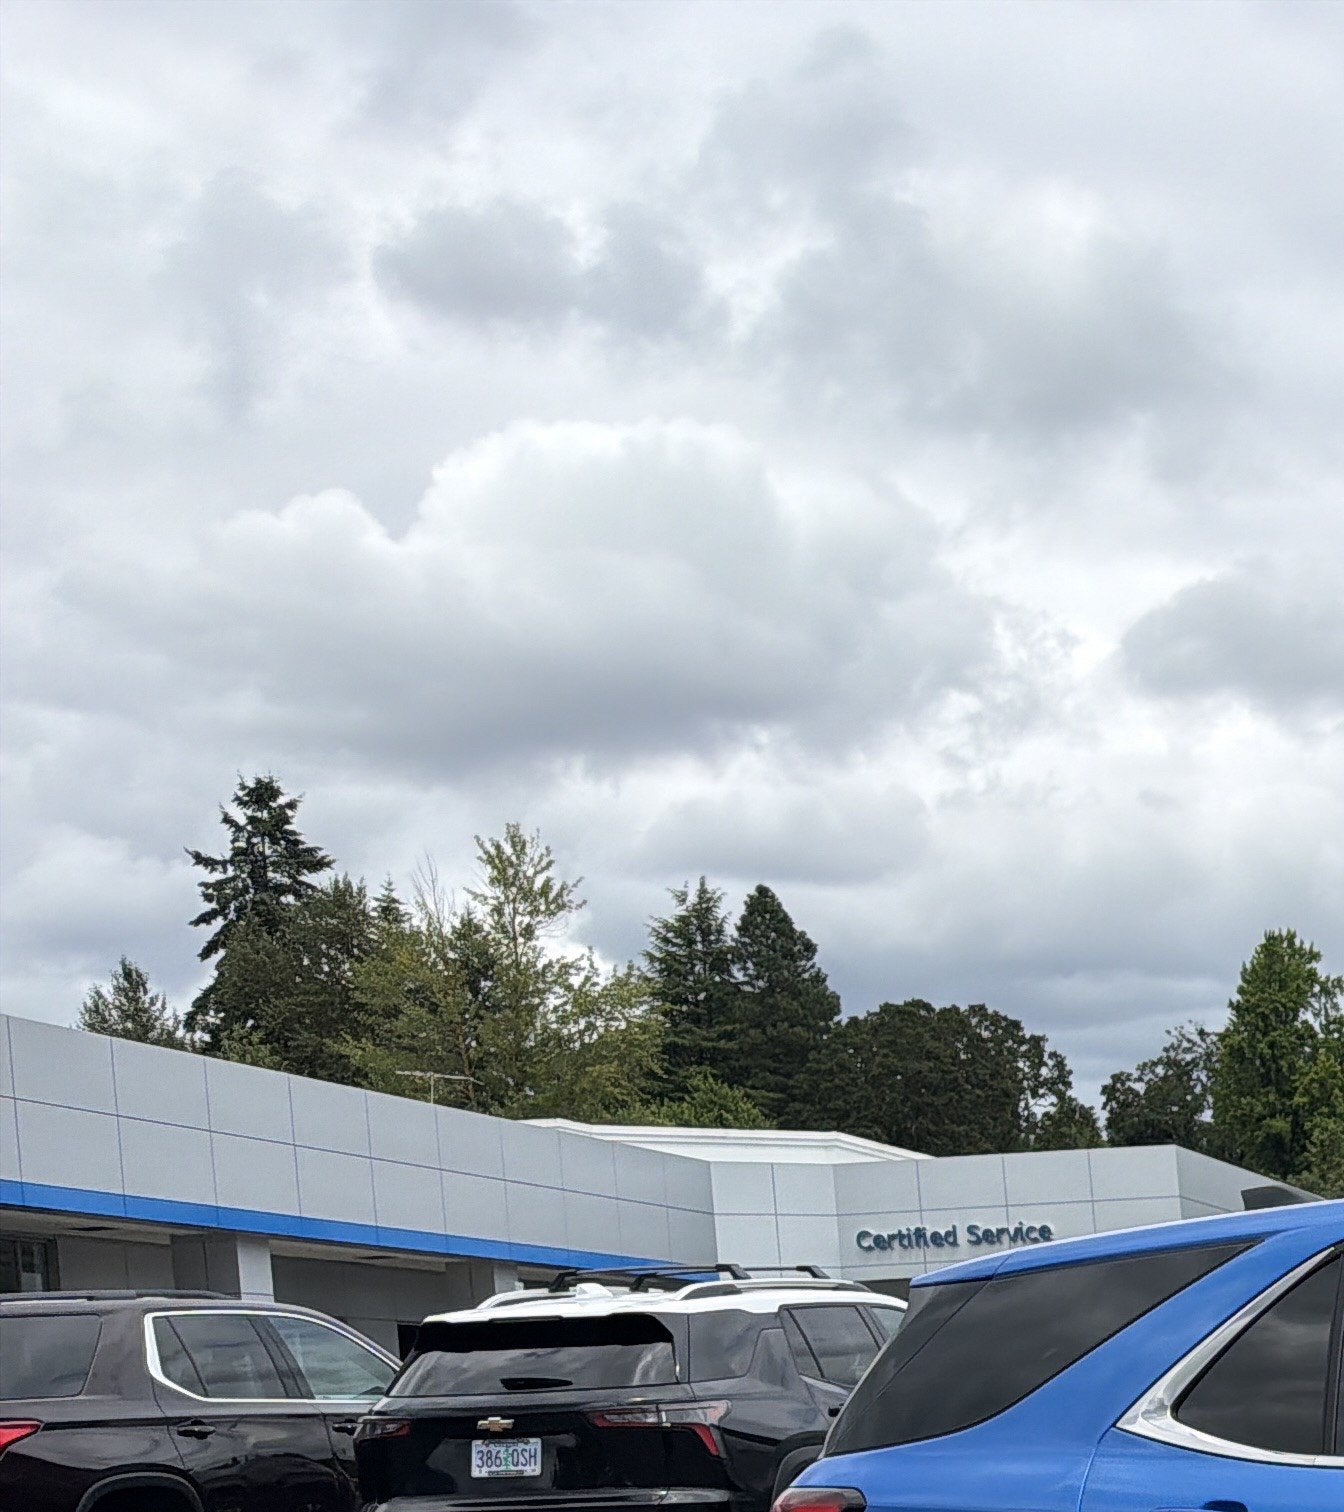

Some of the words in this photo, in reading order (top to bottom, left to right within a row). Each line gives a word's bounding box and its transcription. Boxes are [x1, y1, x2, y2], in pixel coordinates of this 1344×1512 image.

[856, 1225, 959, 1252] Certified
[966, 1221, 1053, 1246] Service
[476, 1449, 502, 1469] 386
